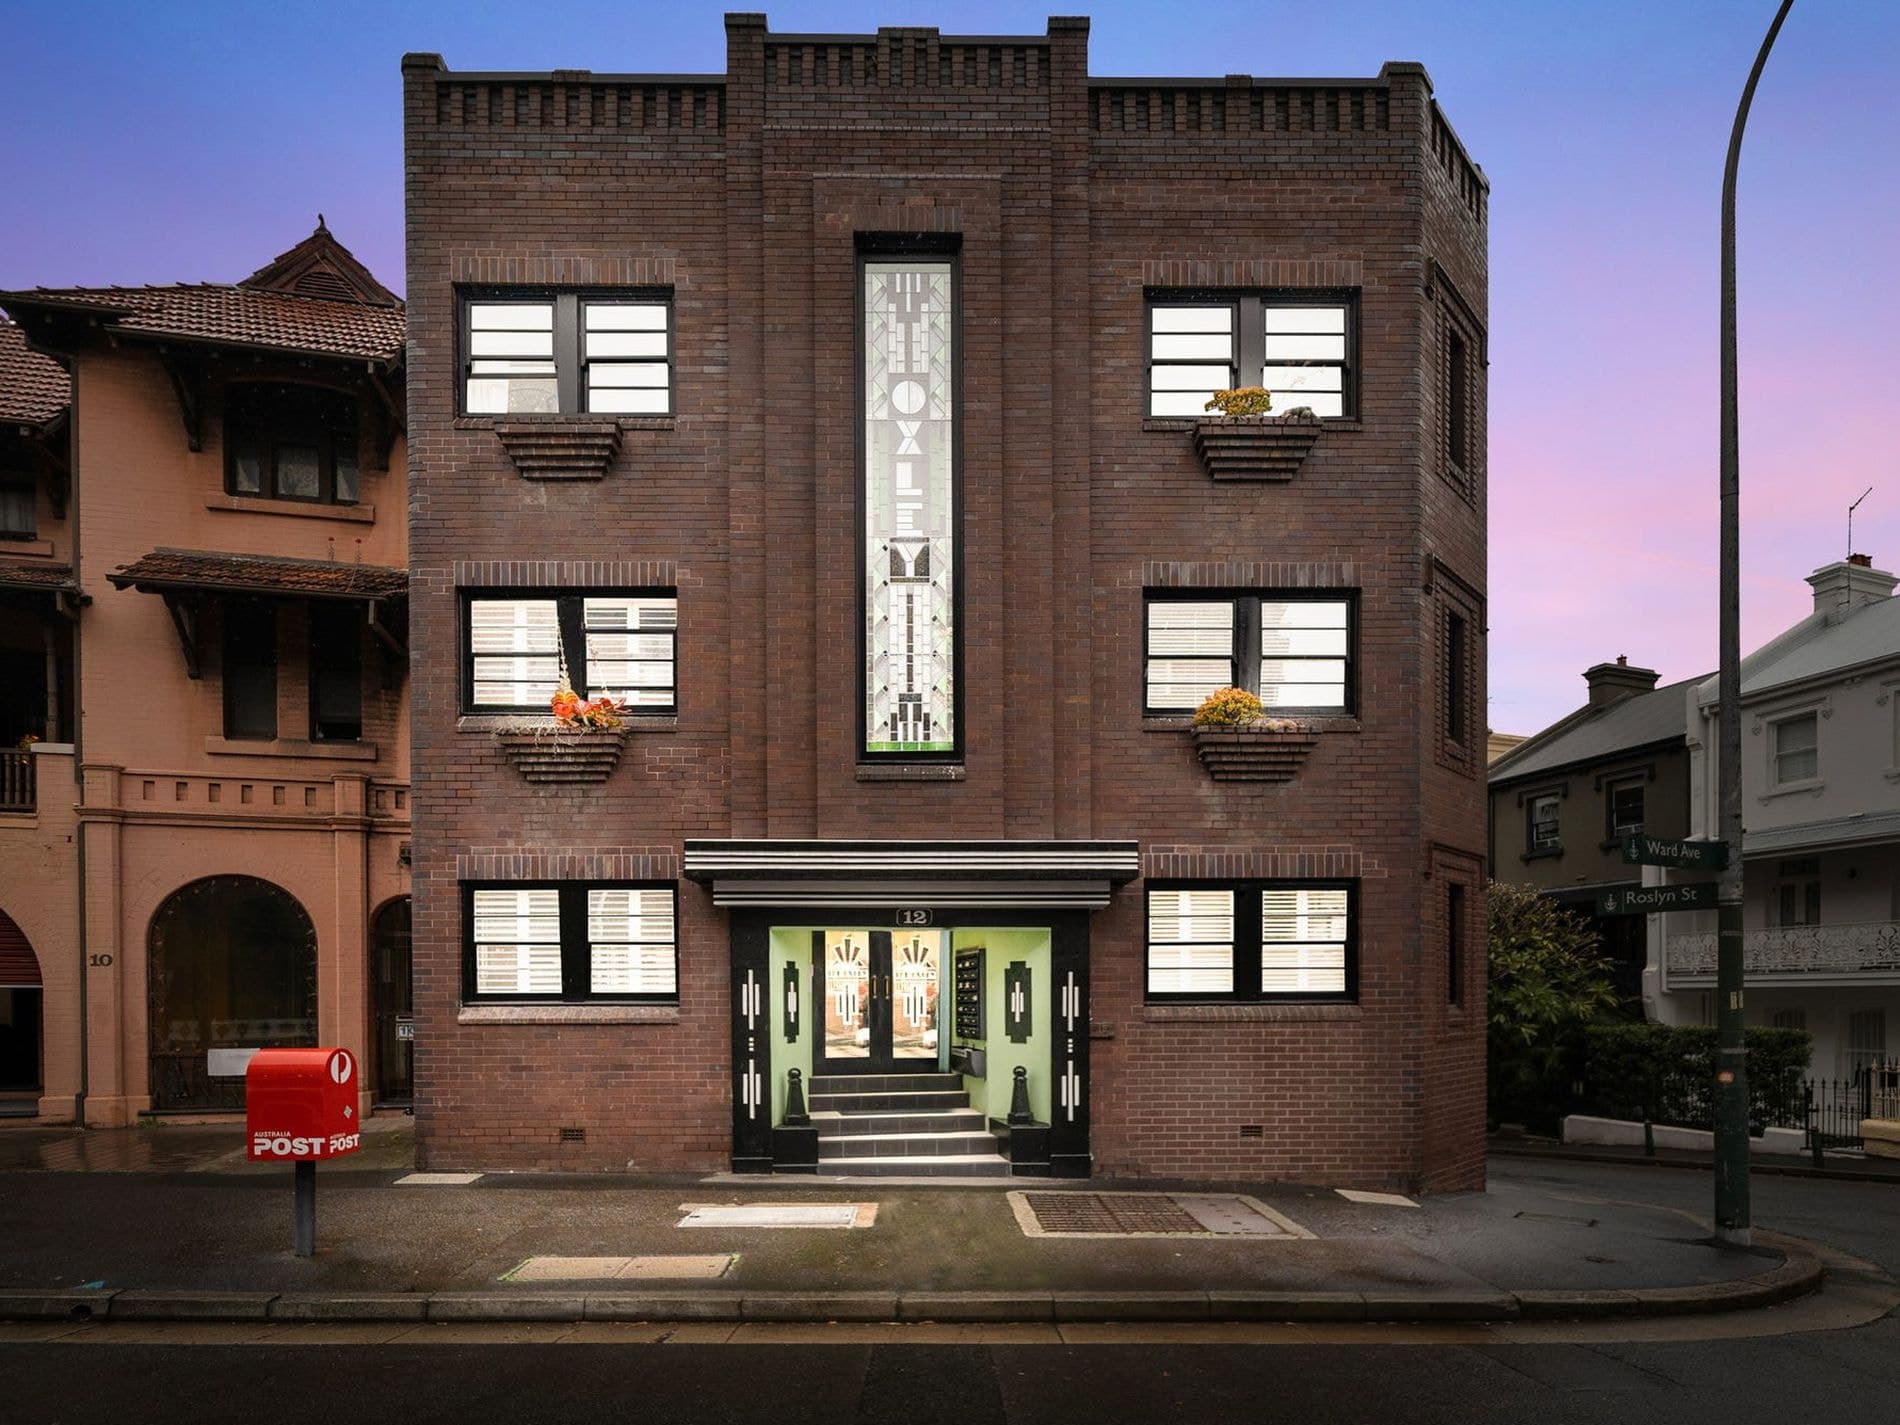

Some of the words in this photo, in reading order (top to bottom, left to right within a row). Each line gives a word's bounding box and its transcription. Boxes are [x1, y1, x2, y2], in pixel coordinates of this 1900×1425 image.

[892, 380, 926, 577] OXLEY
[1647, 840, 1678, 857] Ward
[1681, 844, 1702, 860] Ave
[1626, 890, 1676, 907] Roslyn
[1682, 887, 1698, 901] St
[903, 910, 927, 924] 12
[89, 954, 113, 967] 10
[253, 1137, 325, 1156] POST
[329, 1133, 360, 1154] POST
